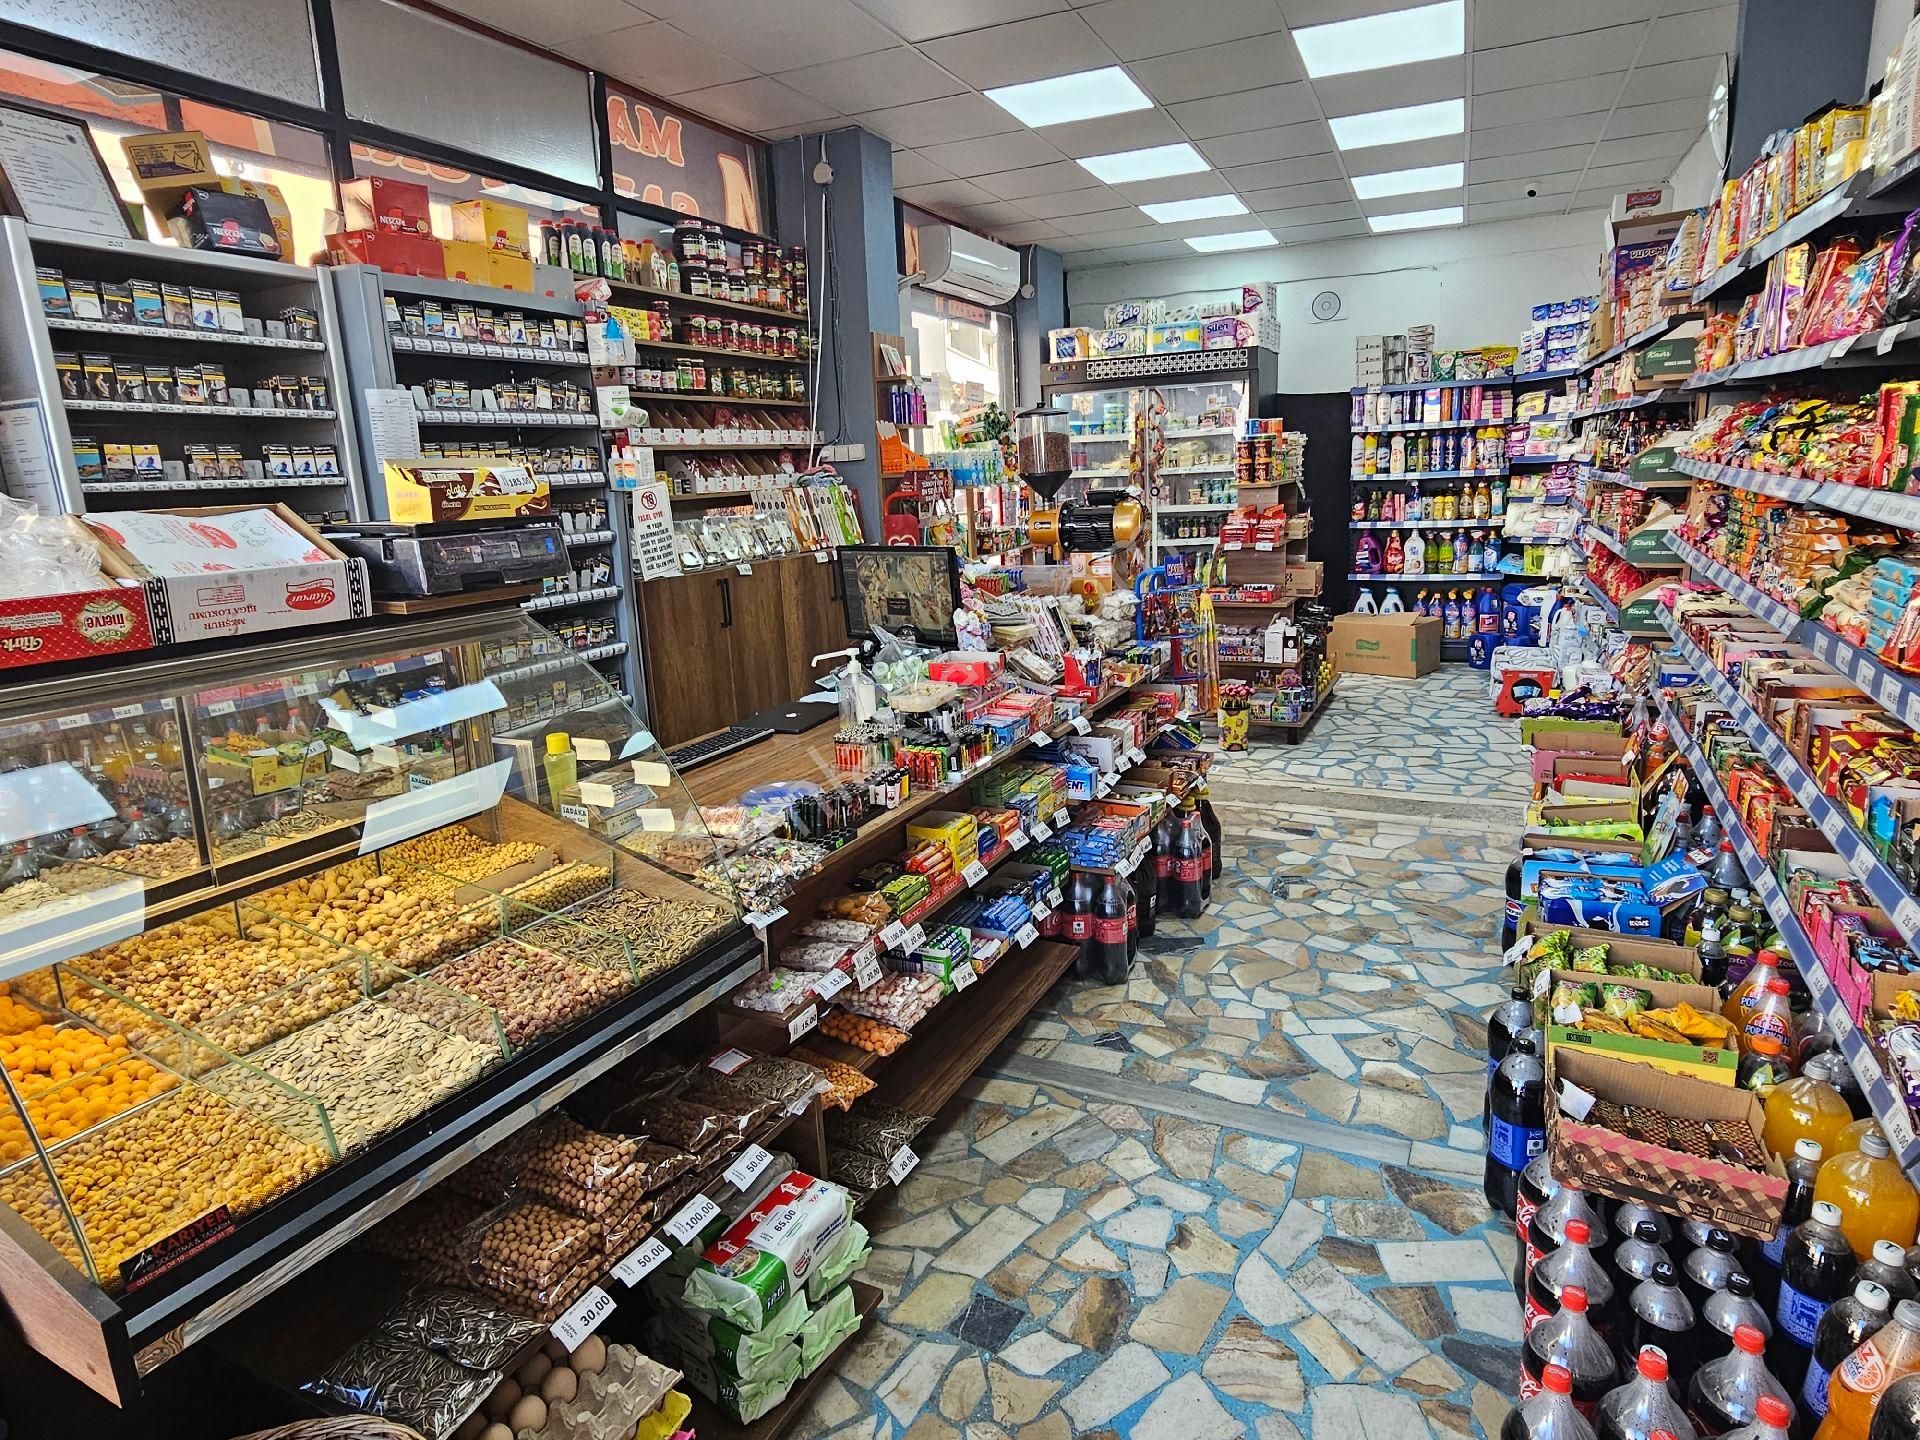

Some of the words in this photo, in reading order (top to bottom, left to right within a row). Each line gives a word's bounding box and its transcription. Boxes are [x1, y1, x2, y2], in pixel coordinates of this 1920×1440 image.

[1116, 306, 1140, 323] Solo
[1206, 322, 1228, 334] Silen
[1102, 332, 1127, 350] Solo
[1646, 350, 1671, 359] Knorr
[1640, 456, 1664, 465] Knorr
[1632, 538, 1657, 547] Knorr
[1627, 607, 1650, 615] Knorr
[563, 806, 587, 817] SADAKA
[802, 1015, 817, 1031] 15,00
[1893, 1124, 1910, 1149] 35,00
[745, 1151, 768, 1173] 50,00
[899, 1152, 916, 1171] 20,00
[686, 1201, 715, 1230] 100,00
[774, 1209, 797, 1232] 65,00
[637, 1244, 666, 1268] 50,00
[579, 1294, 610, 1327] 30,00
